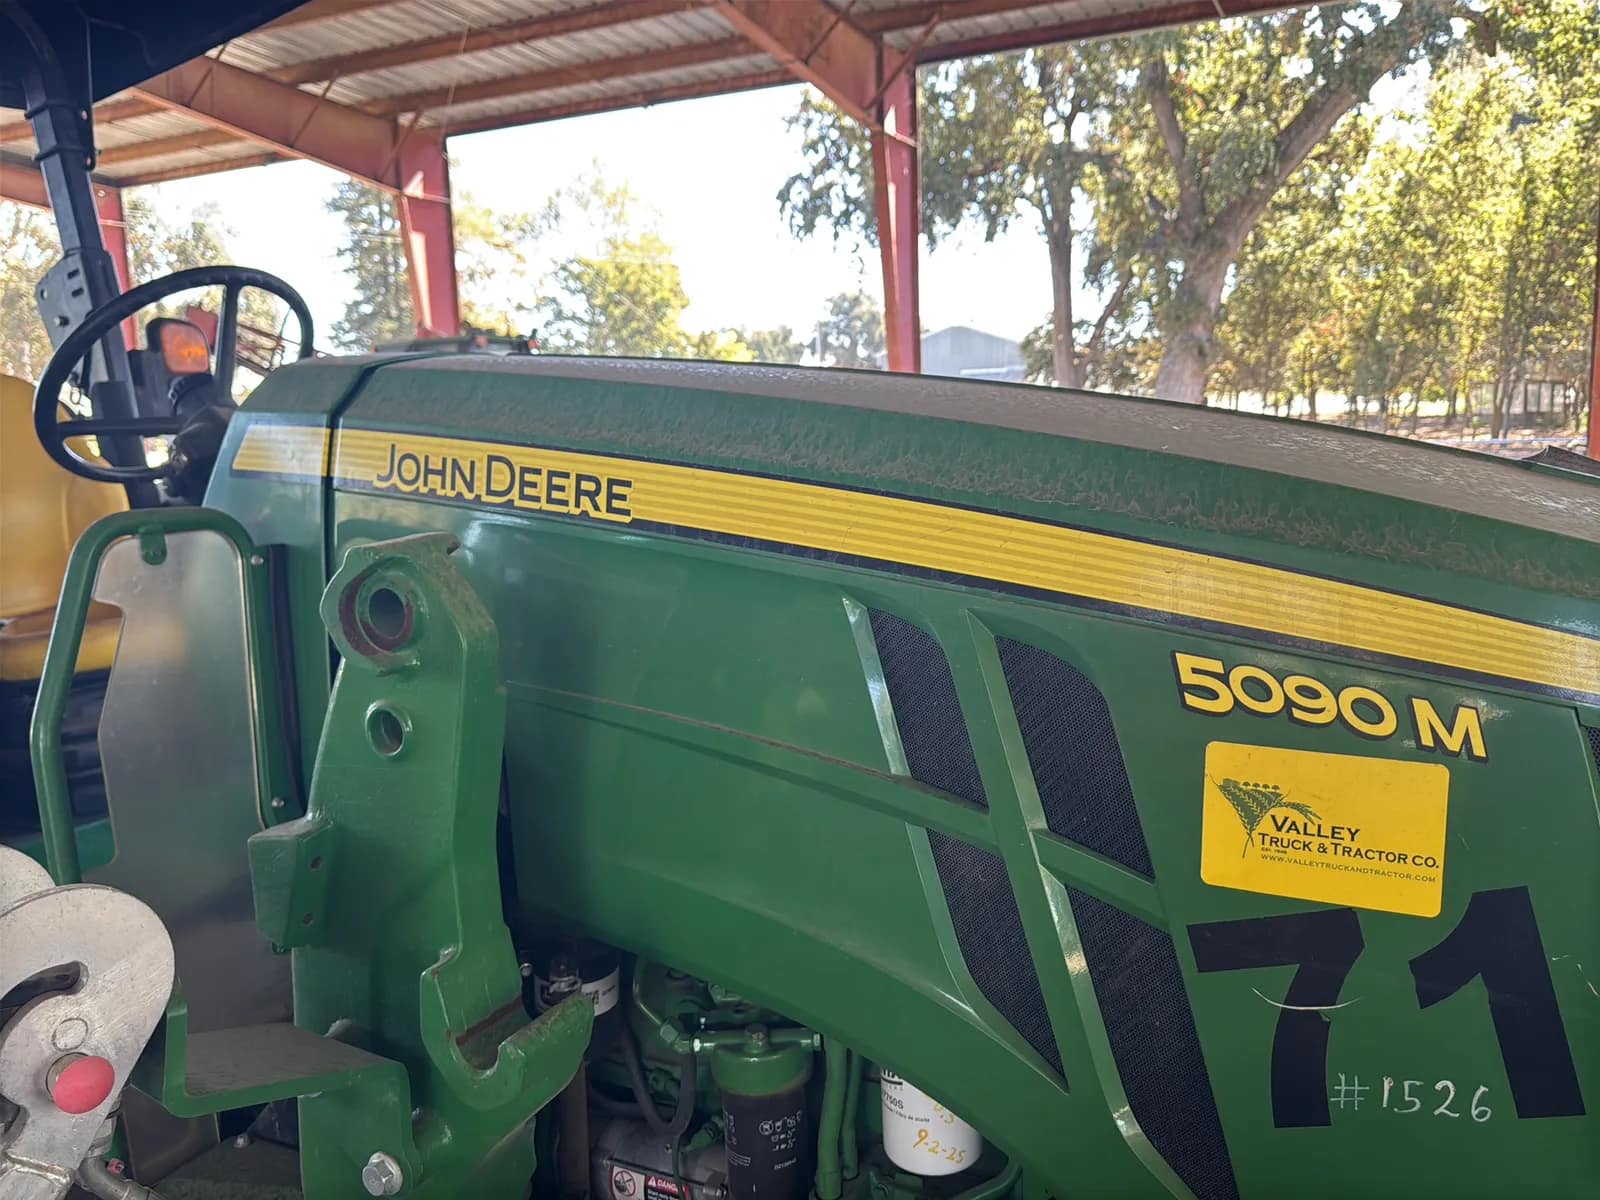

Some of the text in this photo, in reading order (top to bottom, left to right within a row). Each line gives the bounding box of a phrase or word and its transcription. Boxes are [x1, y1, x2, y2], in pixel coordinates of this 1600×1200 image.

[375, 442, 634, 519] JOHN DEERE
[1172, 650, 1488, 761] 5090 M
[1270, 814, 1361, 842] VALLEY
[1257, 832, 1440, 870] TRUCK & TRACTOR CO.
[1260, 853, 1437, 884] WWW.VALLEYTRUCKANDTRACTOR.COM
[1186, 886, 1587, 1128] 71
[1330, 1072, 1493, 1123] #1526
[913, 1128, 967, 1165] 9-2-25
